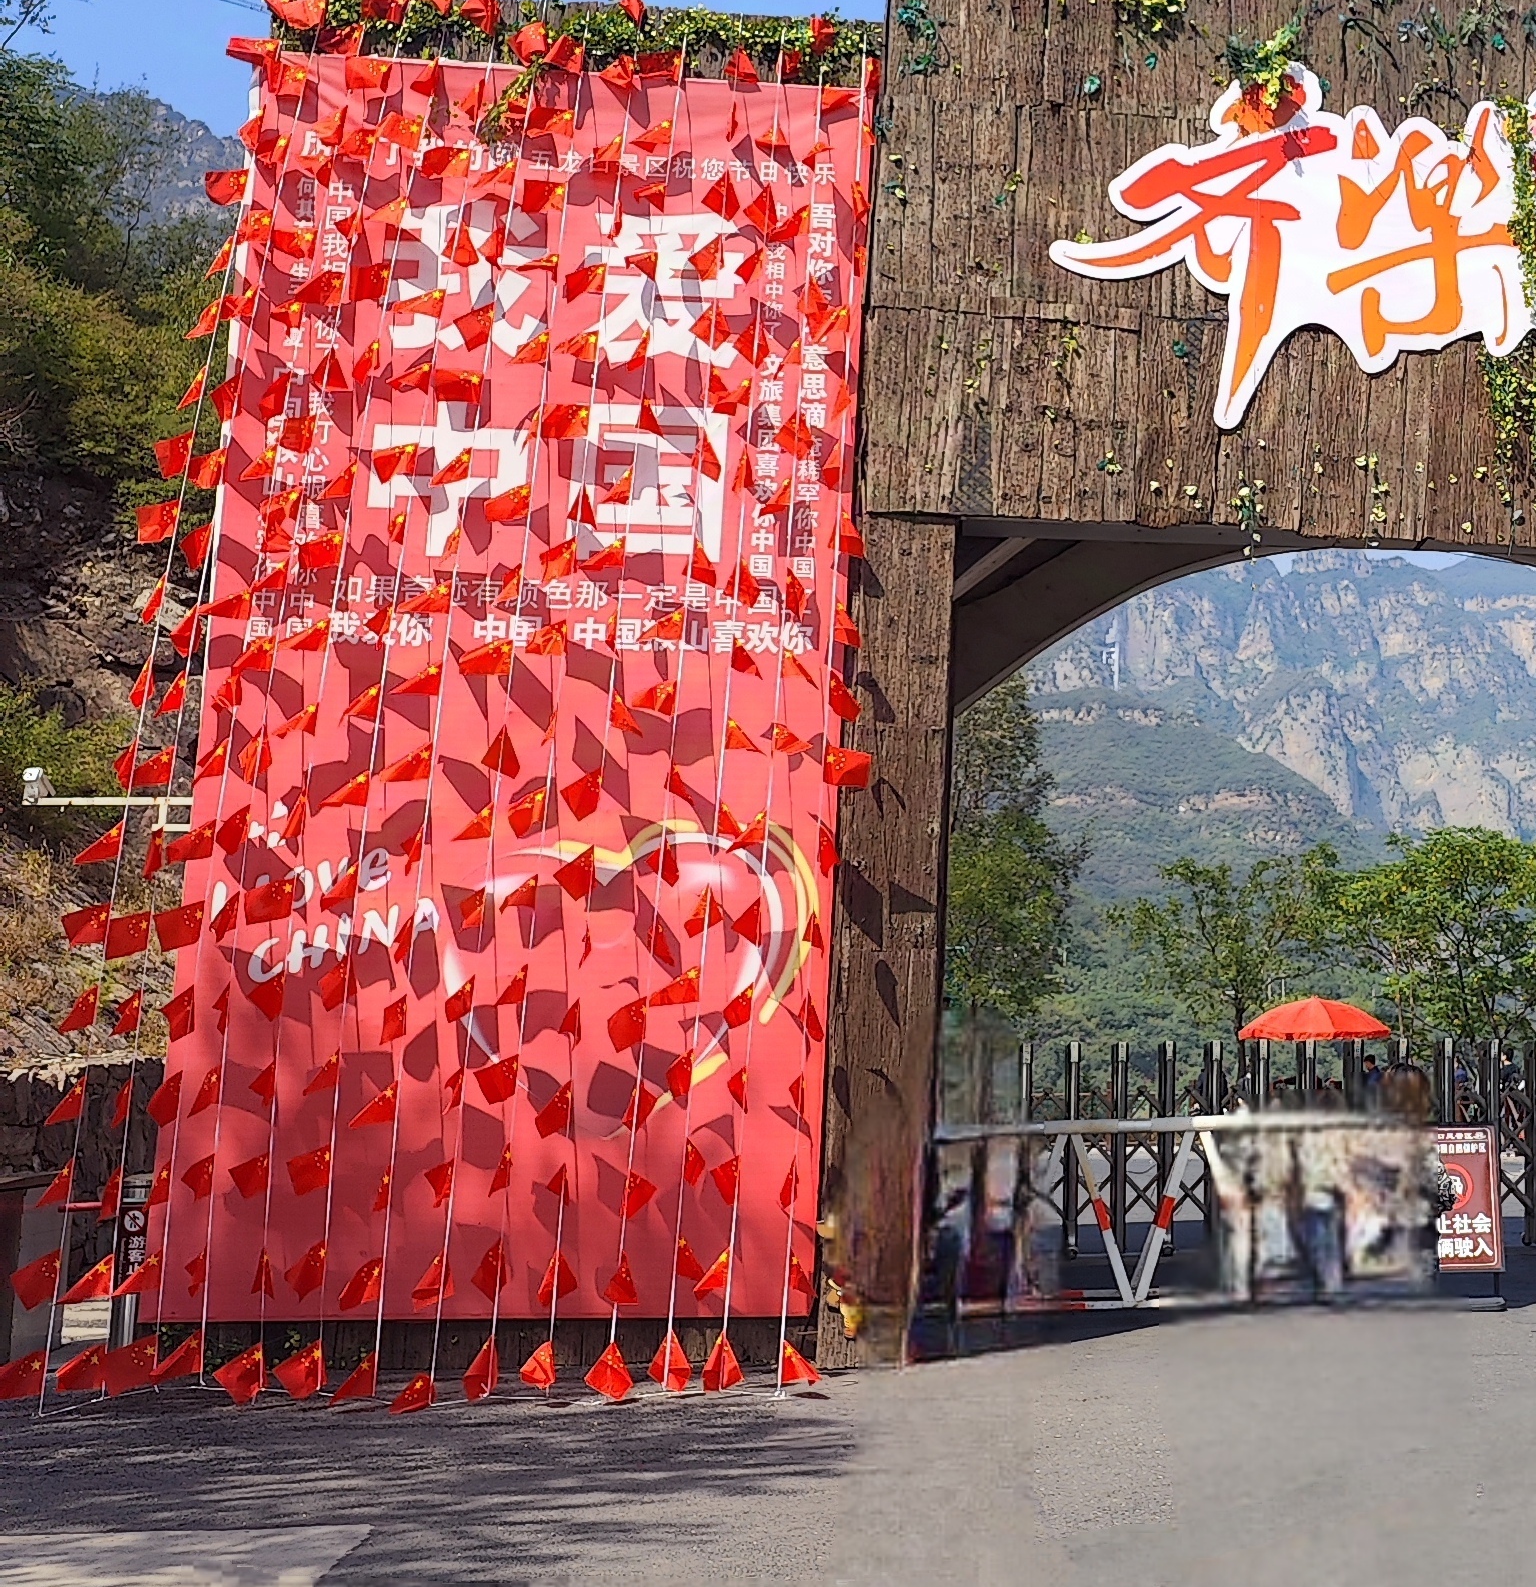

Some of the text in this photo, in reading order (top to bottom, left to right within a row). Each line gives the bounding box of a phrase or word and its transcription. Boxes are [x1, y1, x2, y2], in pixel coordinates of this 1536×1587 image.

[383, 204, 746, 370] 我爱
[366, 400, 730, 564] 中国
[247, 897, 440, 983] CHINA
